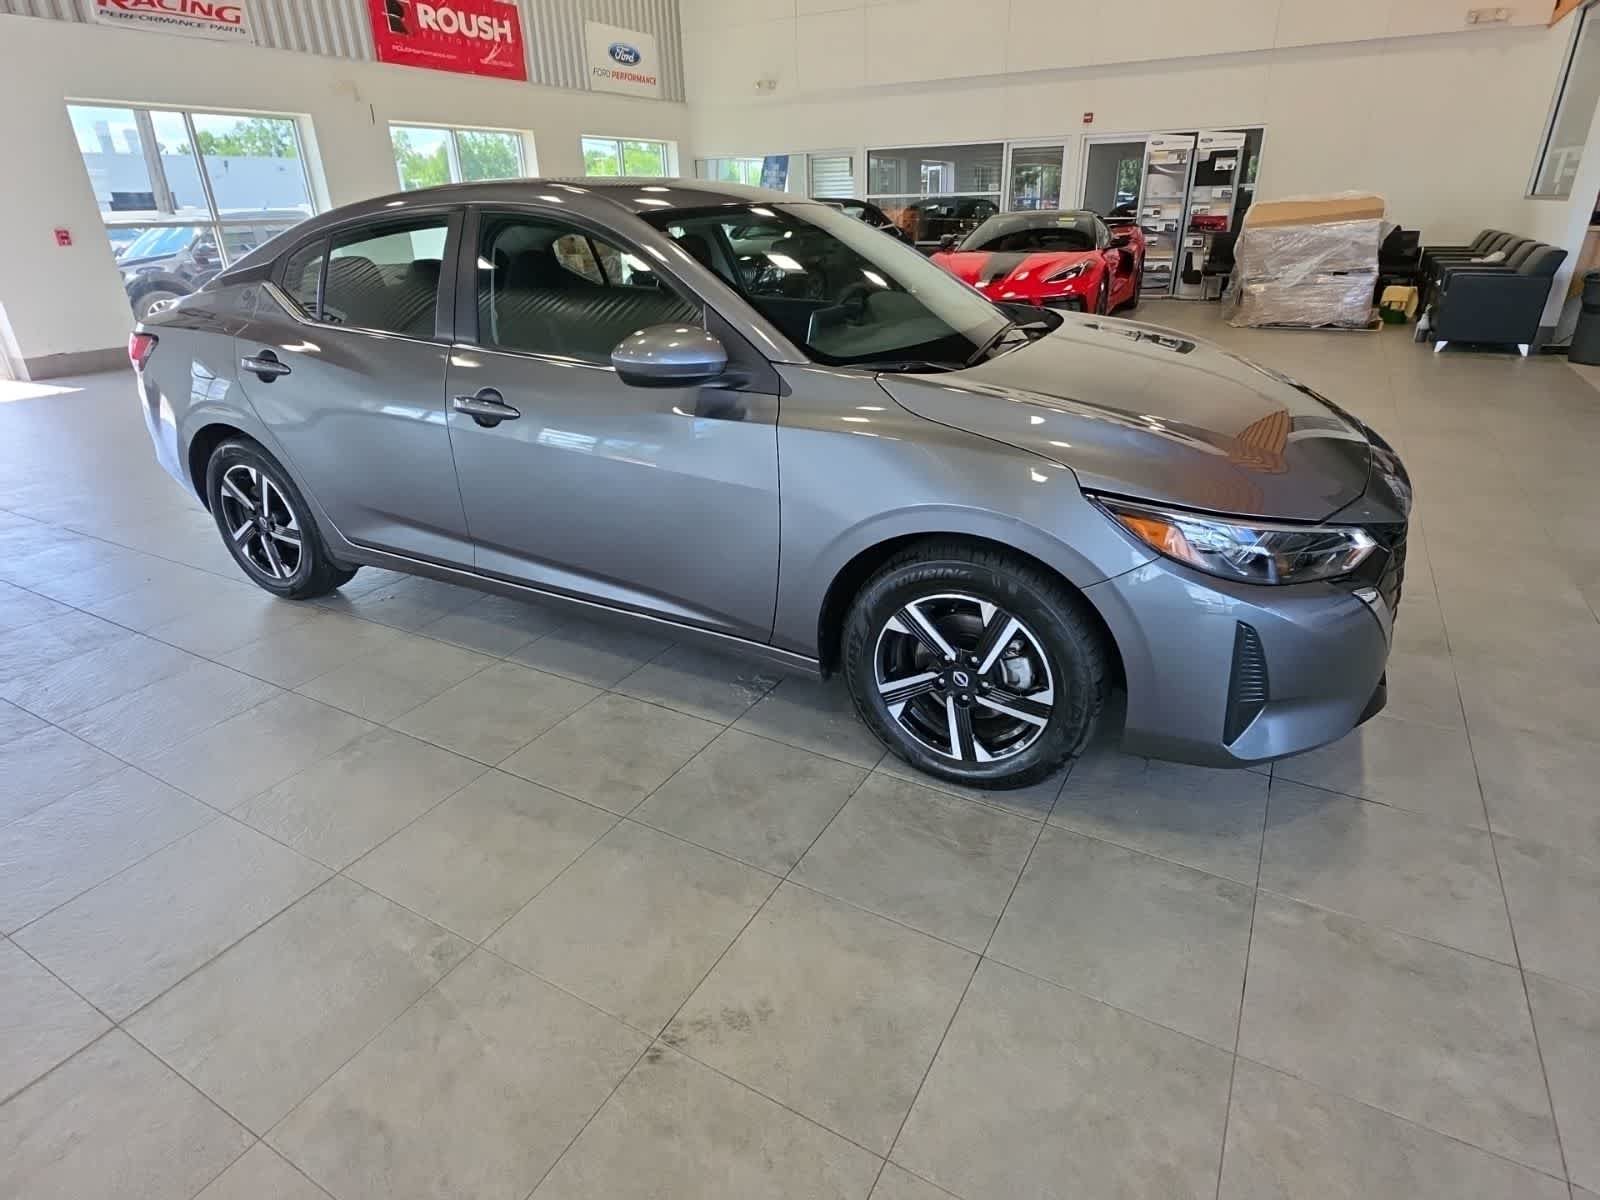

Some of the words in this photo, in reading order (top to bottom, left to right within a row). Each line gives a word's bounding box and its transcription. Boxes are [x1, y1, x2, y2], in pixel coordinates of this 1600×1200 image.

[100, 9, 202, 28] PERFORMANCE
[209, 24, 246, 34] PARTS
[416, 3, 512, 43] ROUSH
[611, 70, 656, 86] PERFORMANCE
